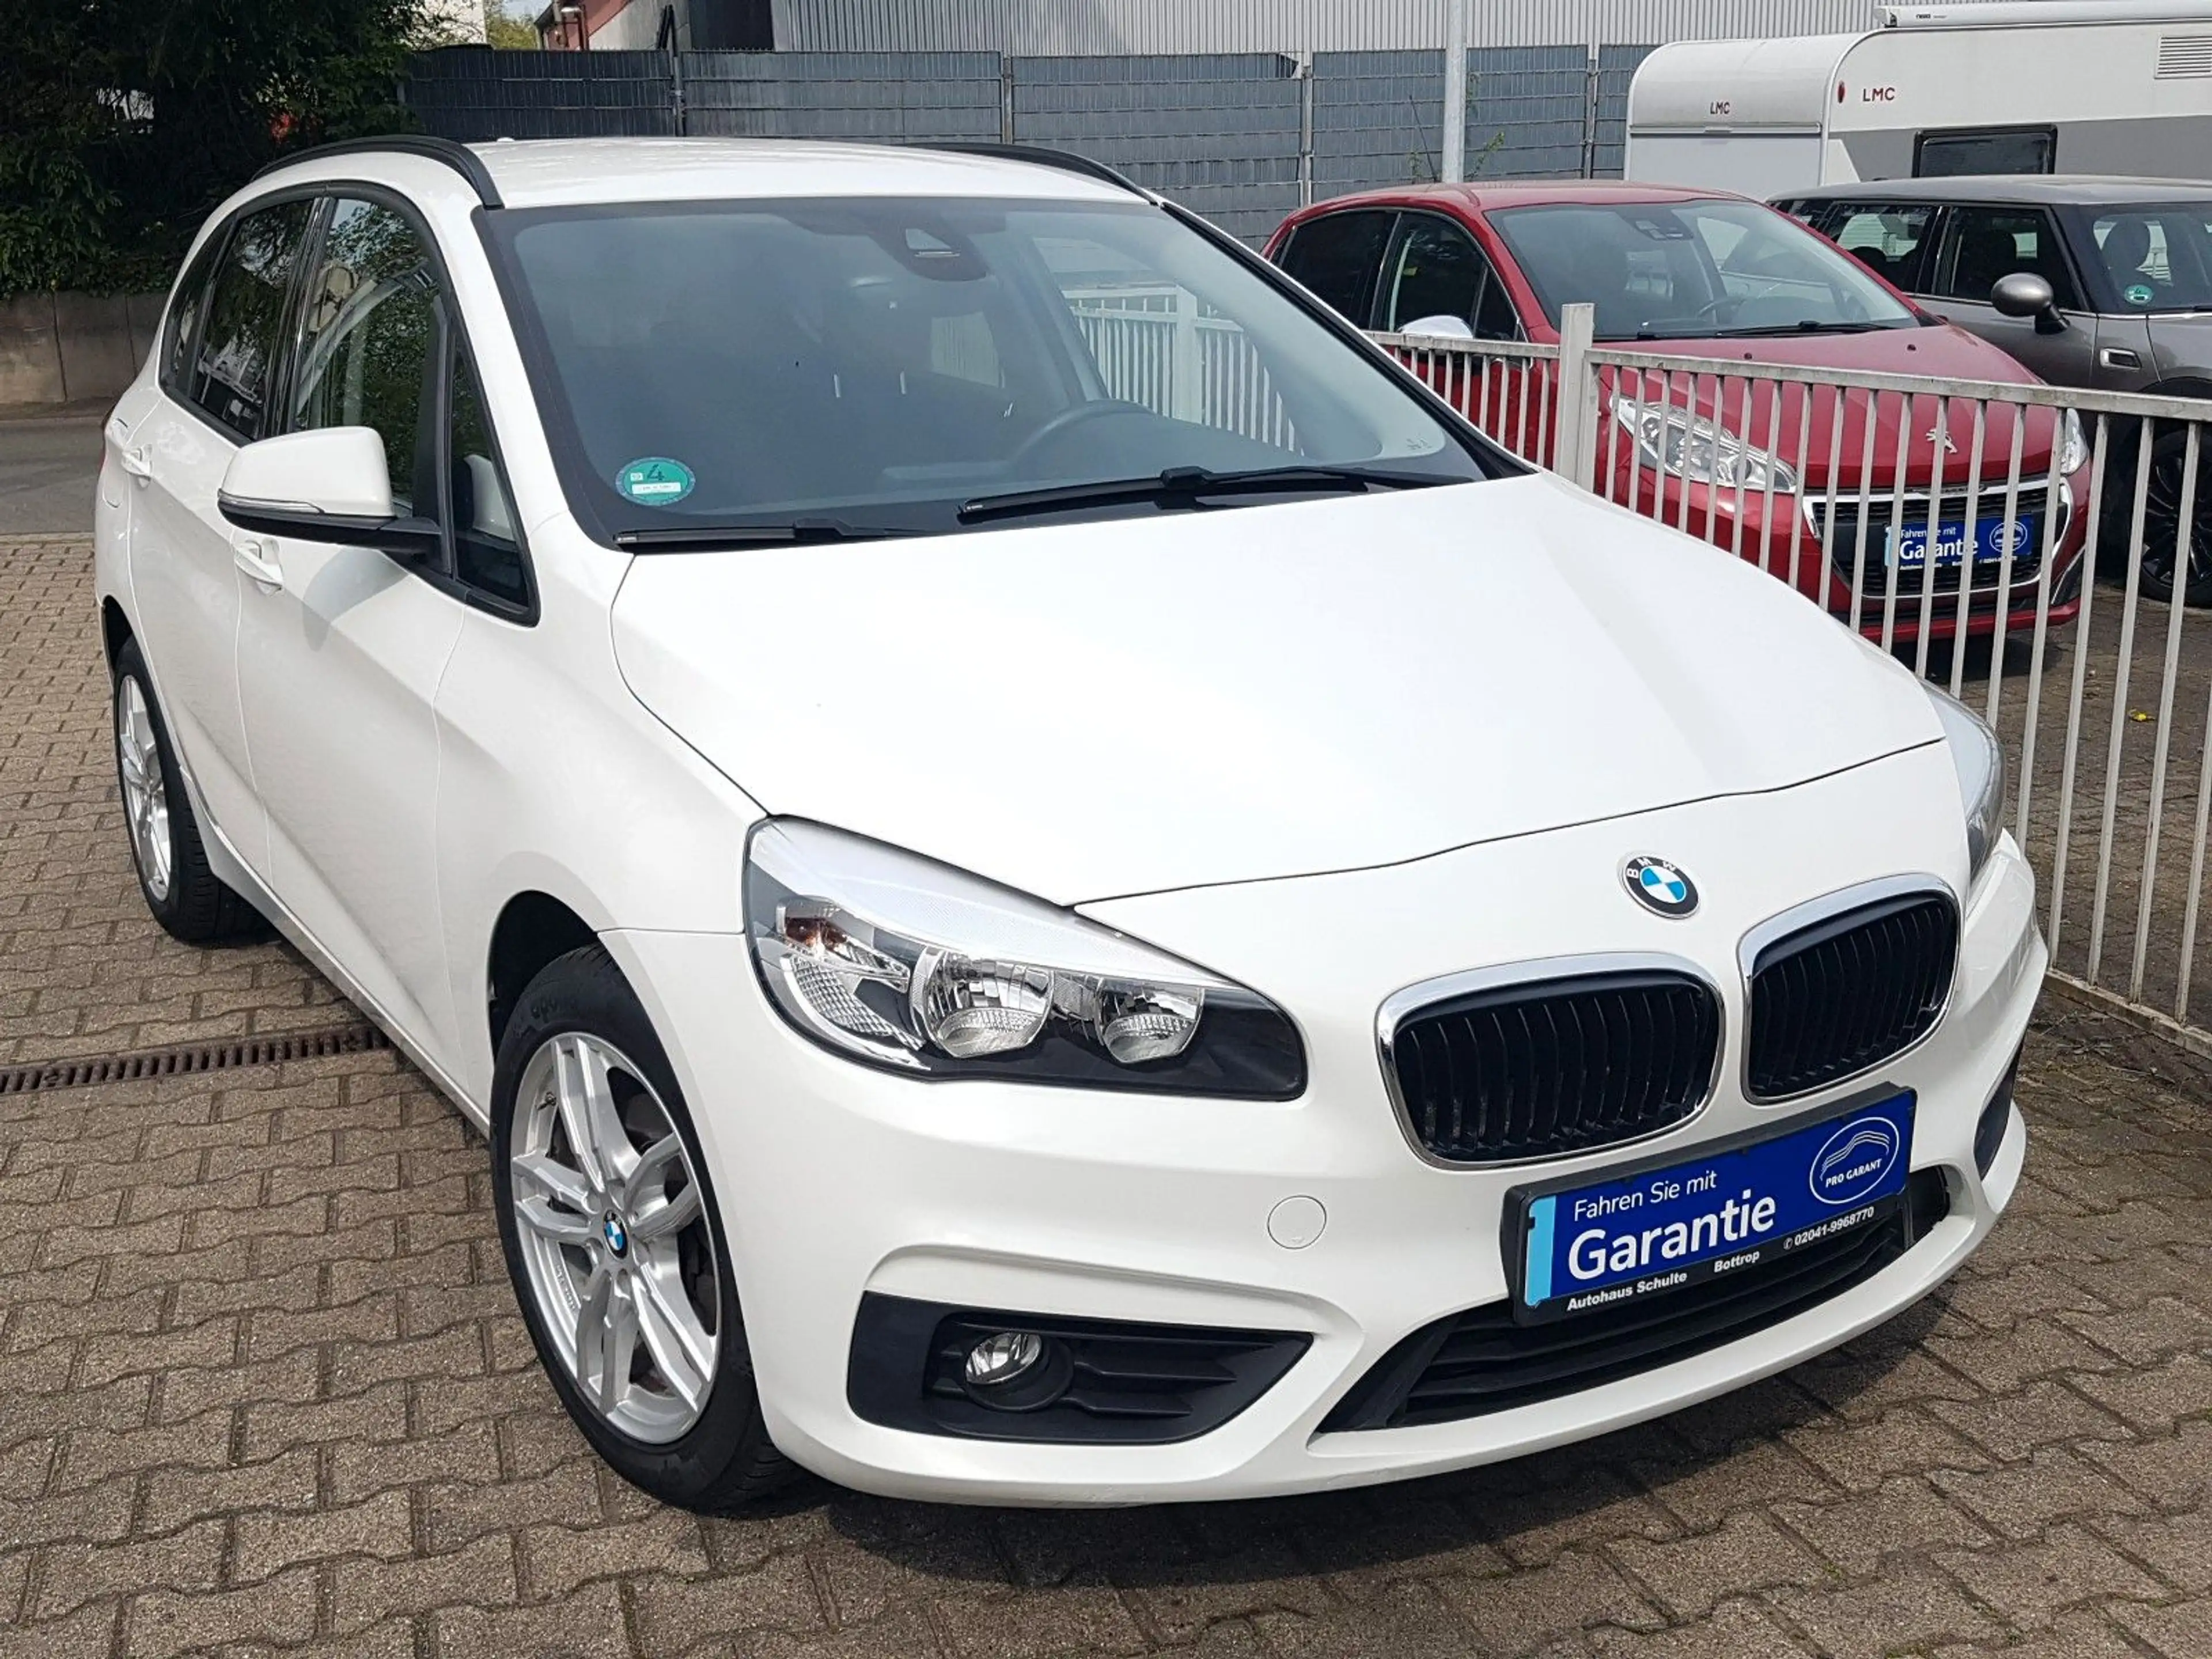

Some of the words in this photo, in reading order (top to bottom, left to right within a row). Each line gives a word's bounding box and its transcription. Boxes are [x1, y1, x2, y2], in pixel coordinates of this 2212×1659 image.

[1862, 87, 1895, 102] LMC
[1709, 101, 1730, 115] LMC
[647, 463, 665, 480] 4
[1900, 539, 1978, 559] Gaante
[1626, 857, 1677, 879] BMW
[1825, 1173, 1844, 1188] PRO
[1846, 1158, 1883, 1180] GARANT
[1574, 1192, 1643, 1221] Fahren
[1650, 1180, 1680, 1203] Sie
[1686, 1170, 1718, 1195] mit
[1568, 1188, 1776, 1280] Garantie
[1566, 1286, 1633, 1311] Autohaus
[1637, 1272, 1687, 1293] Schulte
[1714, 1250, 1760, 1273] Bottrop
[1794, 1206, 1874, 1246] 02041-9968770
